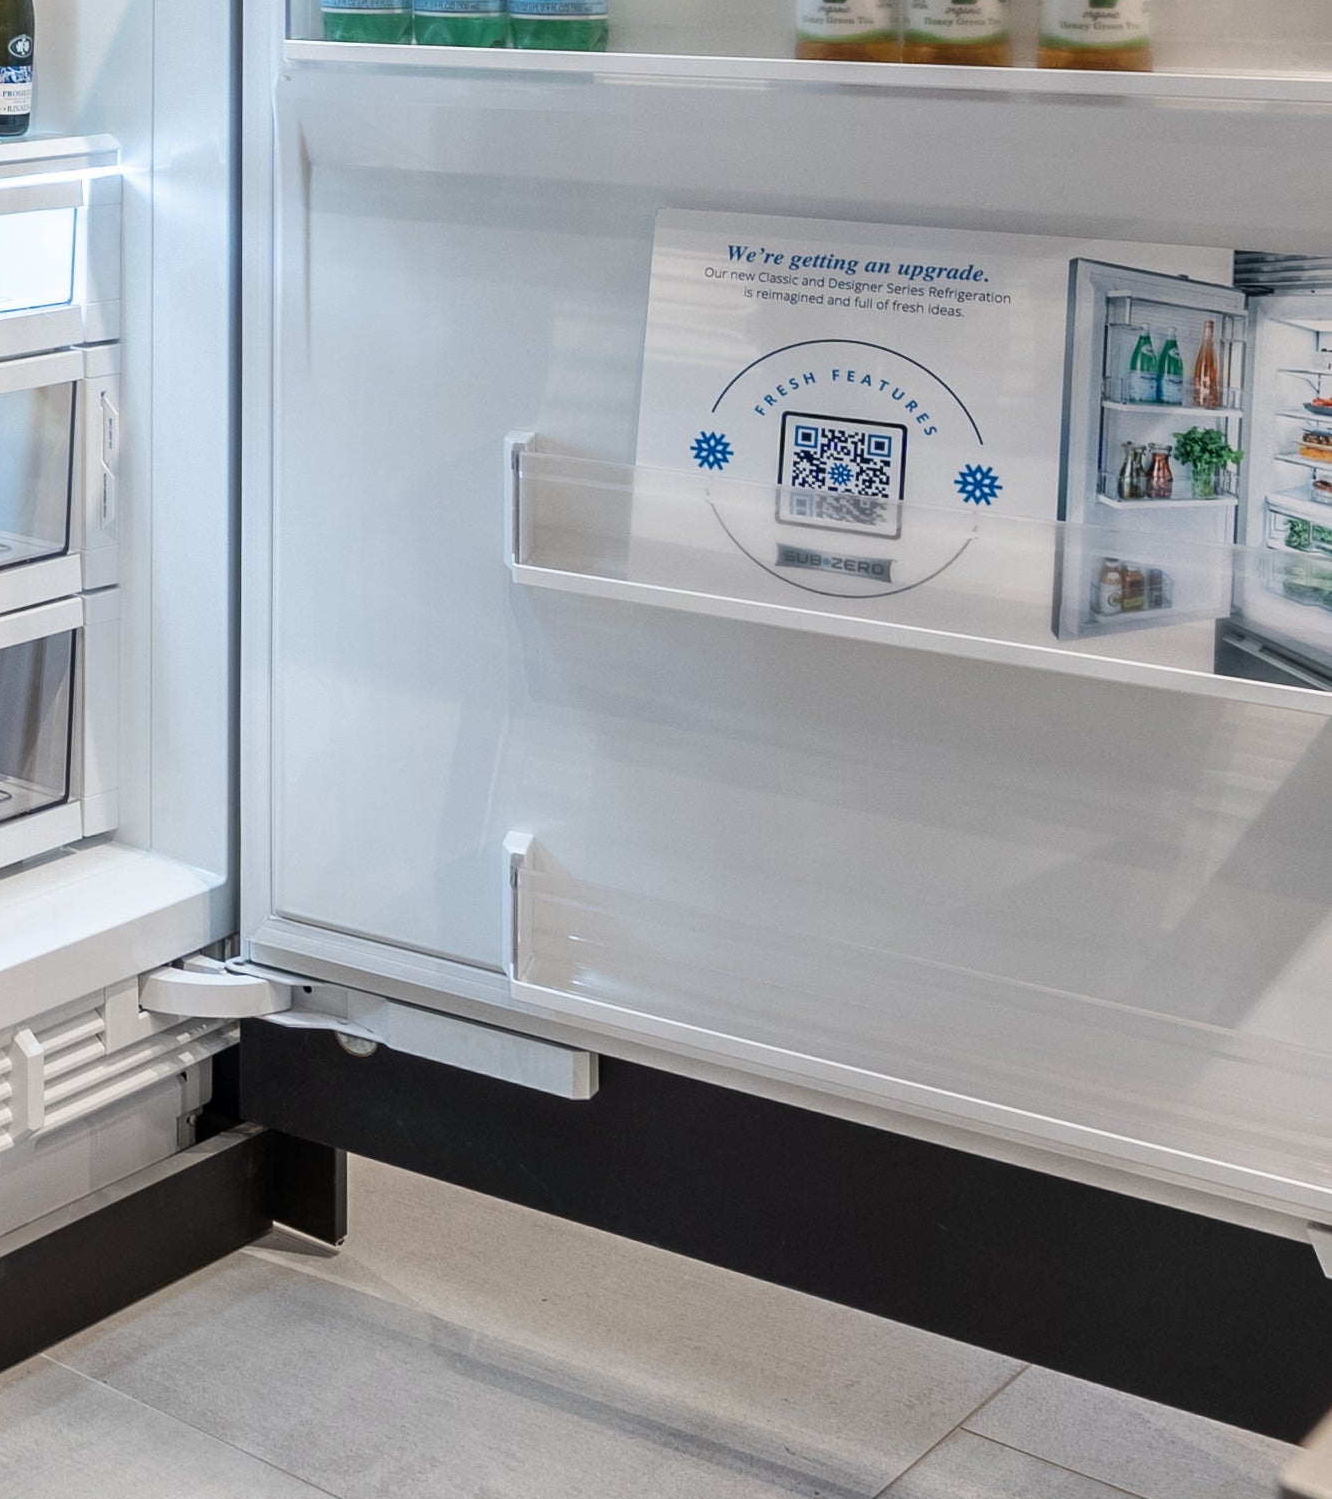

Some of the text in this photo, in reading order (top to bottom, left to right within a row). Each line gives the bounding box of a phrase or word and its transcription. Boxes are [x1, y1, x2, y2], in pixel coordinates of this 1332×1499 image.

[727, 244, 990, 284] We're getting an upgrade.
[704, 266, 1012, 305] Our new Classic and Designer Series Refrigeration
[743, 286, 966, 318] is reimagined and full of fresh ideas.
[754, 369, 938, 437] FRESH FEATURES
